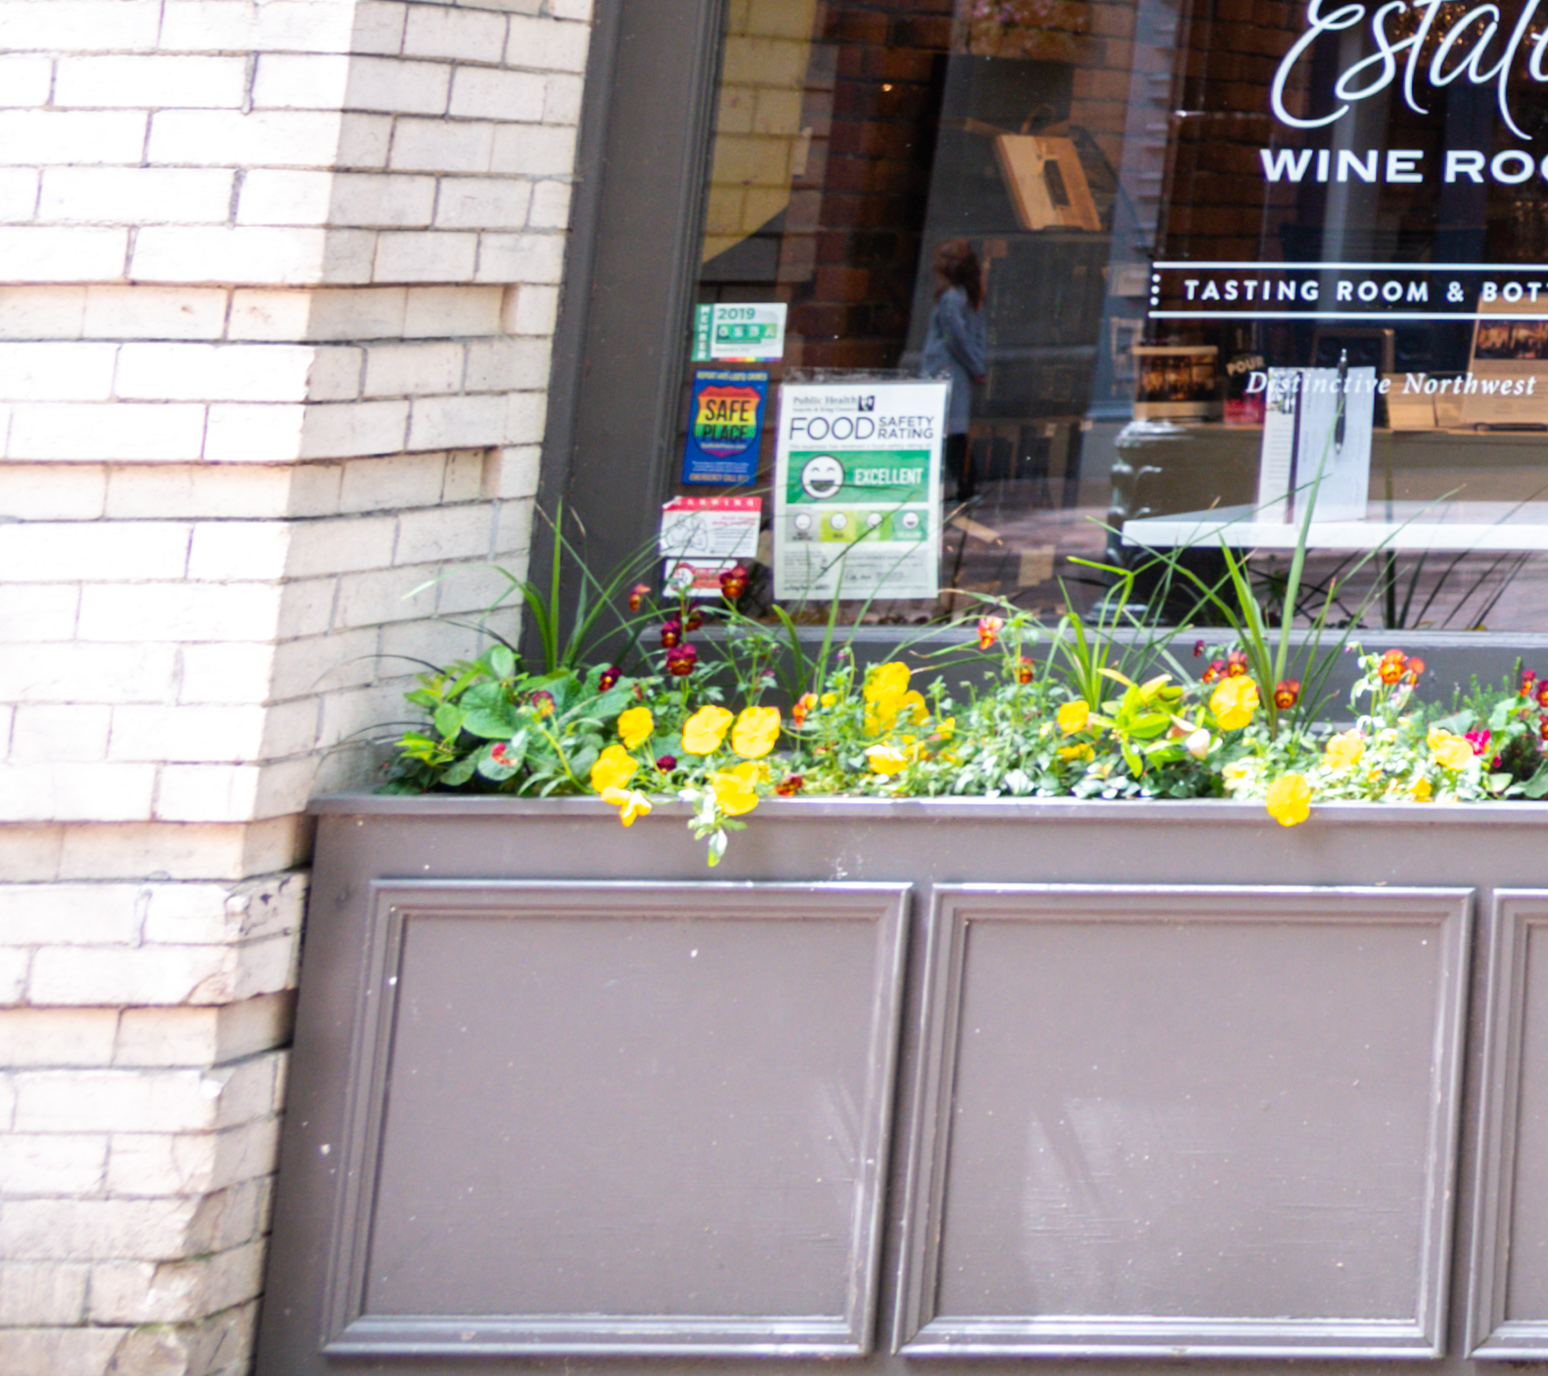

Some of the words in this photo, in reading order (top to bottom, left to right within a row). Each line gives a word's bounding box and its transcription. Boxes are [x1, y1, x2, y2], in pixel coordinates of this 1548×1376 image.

[1260, 149, 1424, 183] WINE
[1185, 280, 1320, 303] TASTING
[1336, 281, 1430, 304] ROOM
[1447, 281, 1465, 304] &
[717, 307, 756, 320] 2019
[1246, 370, 1391, 396] Distinctive
[1402, 370, 1536, 397] Northwest
[705, 399, 751, 422] SAFE
[701, 425, 748, 443] PLACE
[789, 416, 876, 440] FOOD
[878, 416, 936, 427] SAFETY
[877, 428, 934, 440] RATING
[854, 468, 924, 485] EXCELLENT
